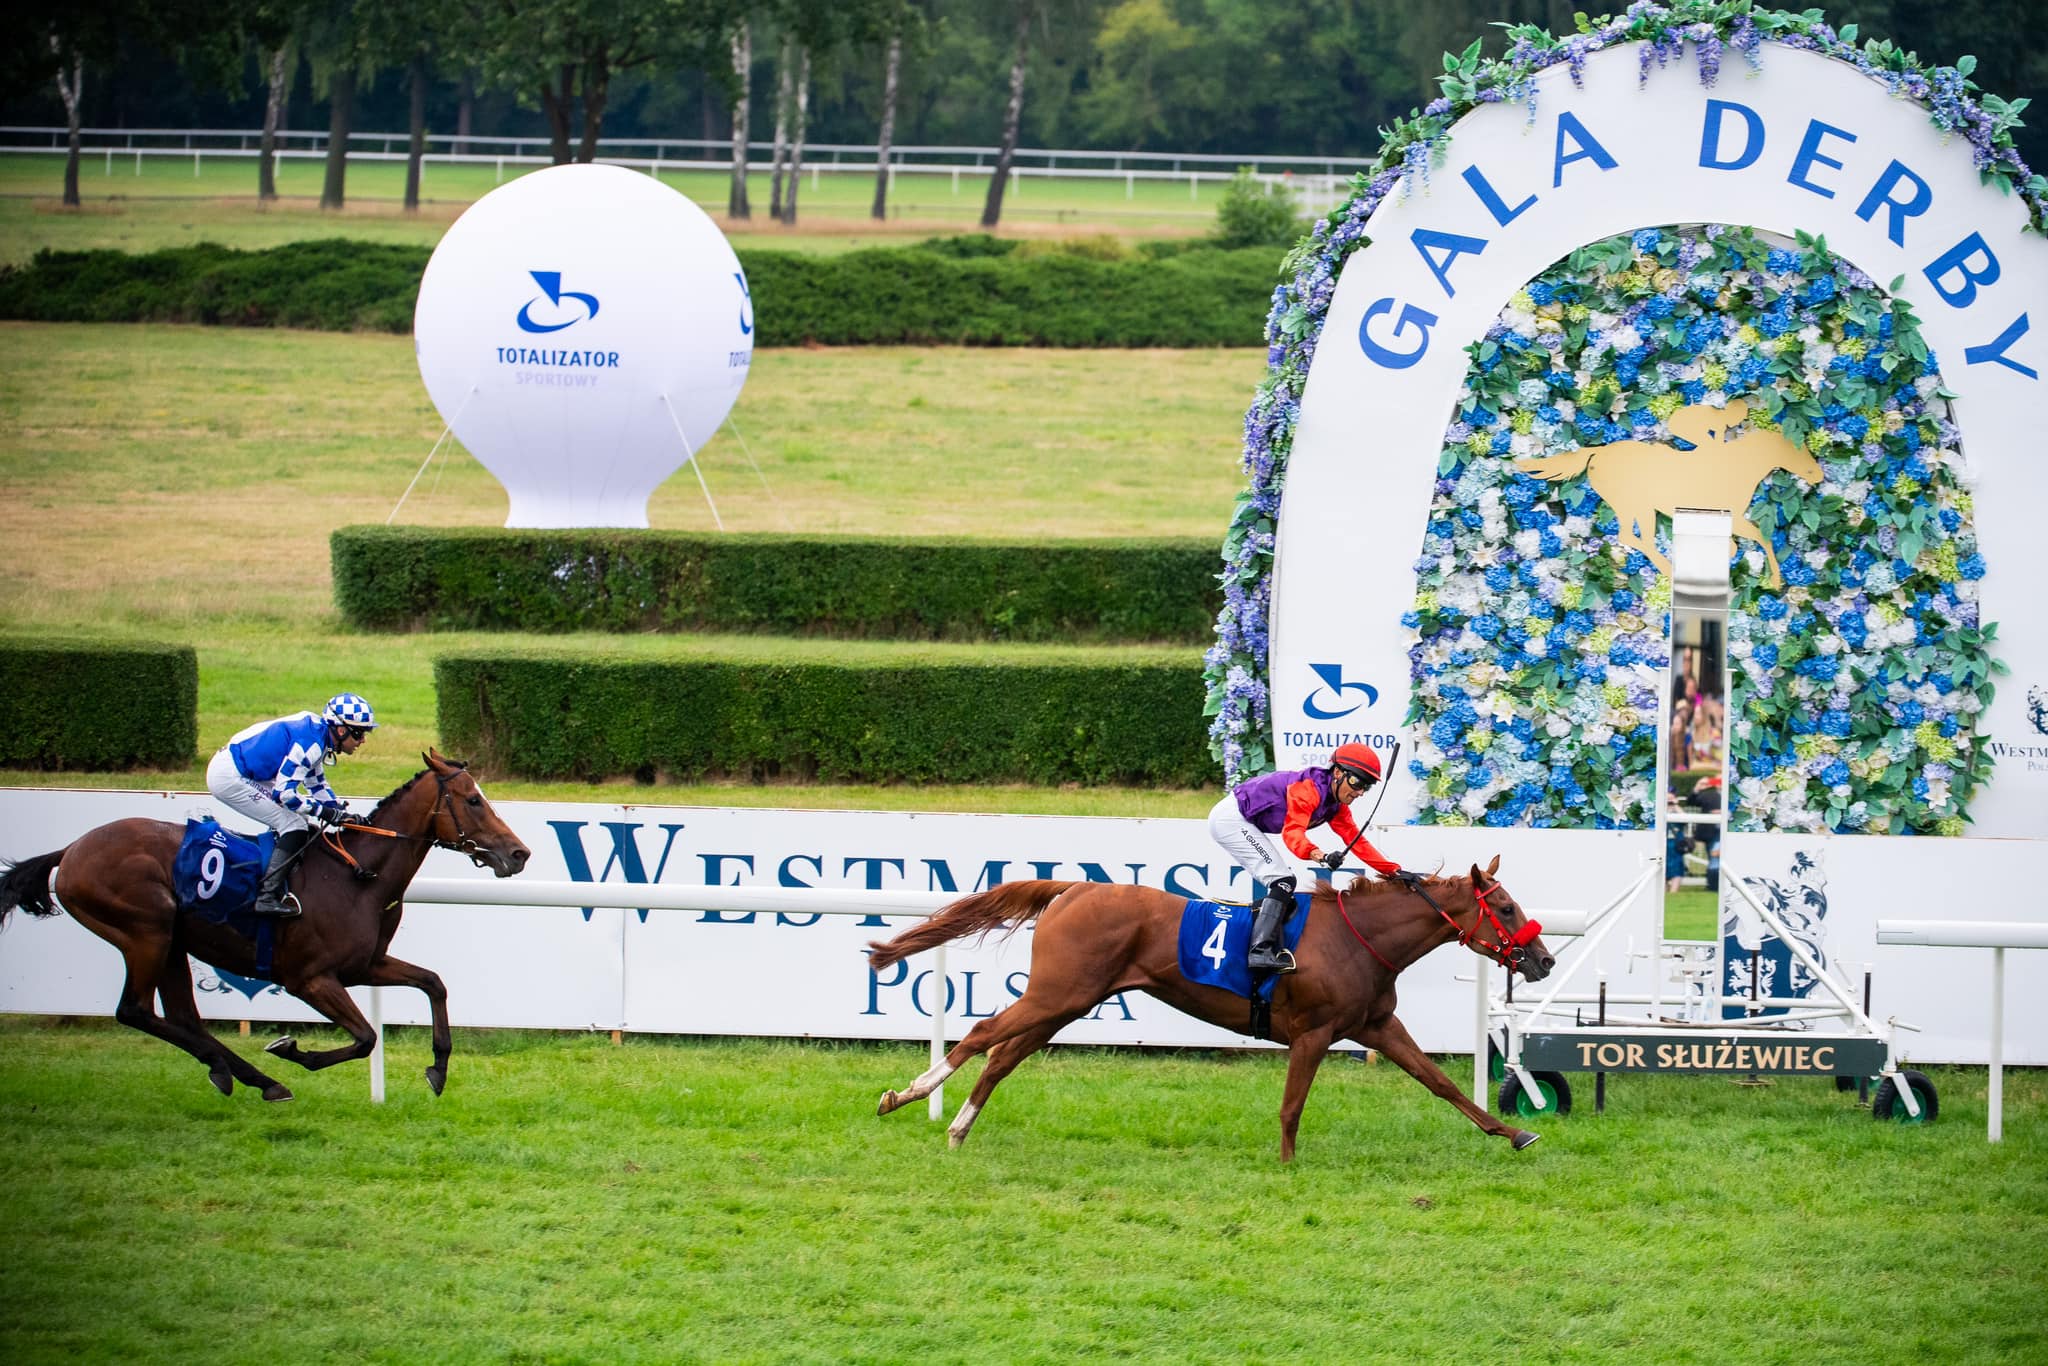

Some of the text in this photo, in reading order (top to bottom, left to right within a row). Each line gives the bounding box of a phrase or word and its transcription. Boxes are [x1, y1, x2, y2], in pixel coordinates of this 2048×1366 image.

[1359, 99, 2038, 379] GALA DERBY
[496, 347, 620, 368] TOTALIZATOR
[515, 371, 599, 387] SPORTOWY
[197, 848, 225, 899] 9
[1202, 920, 1227, 970] 4
[1577, 1039, 1835, 1070] TOR SŁUŻEWIEC
